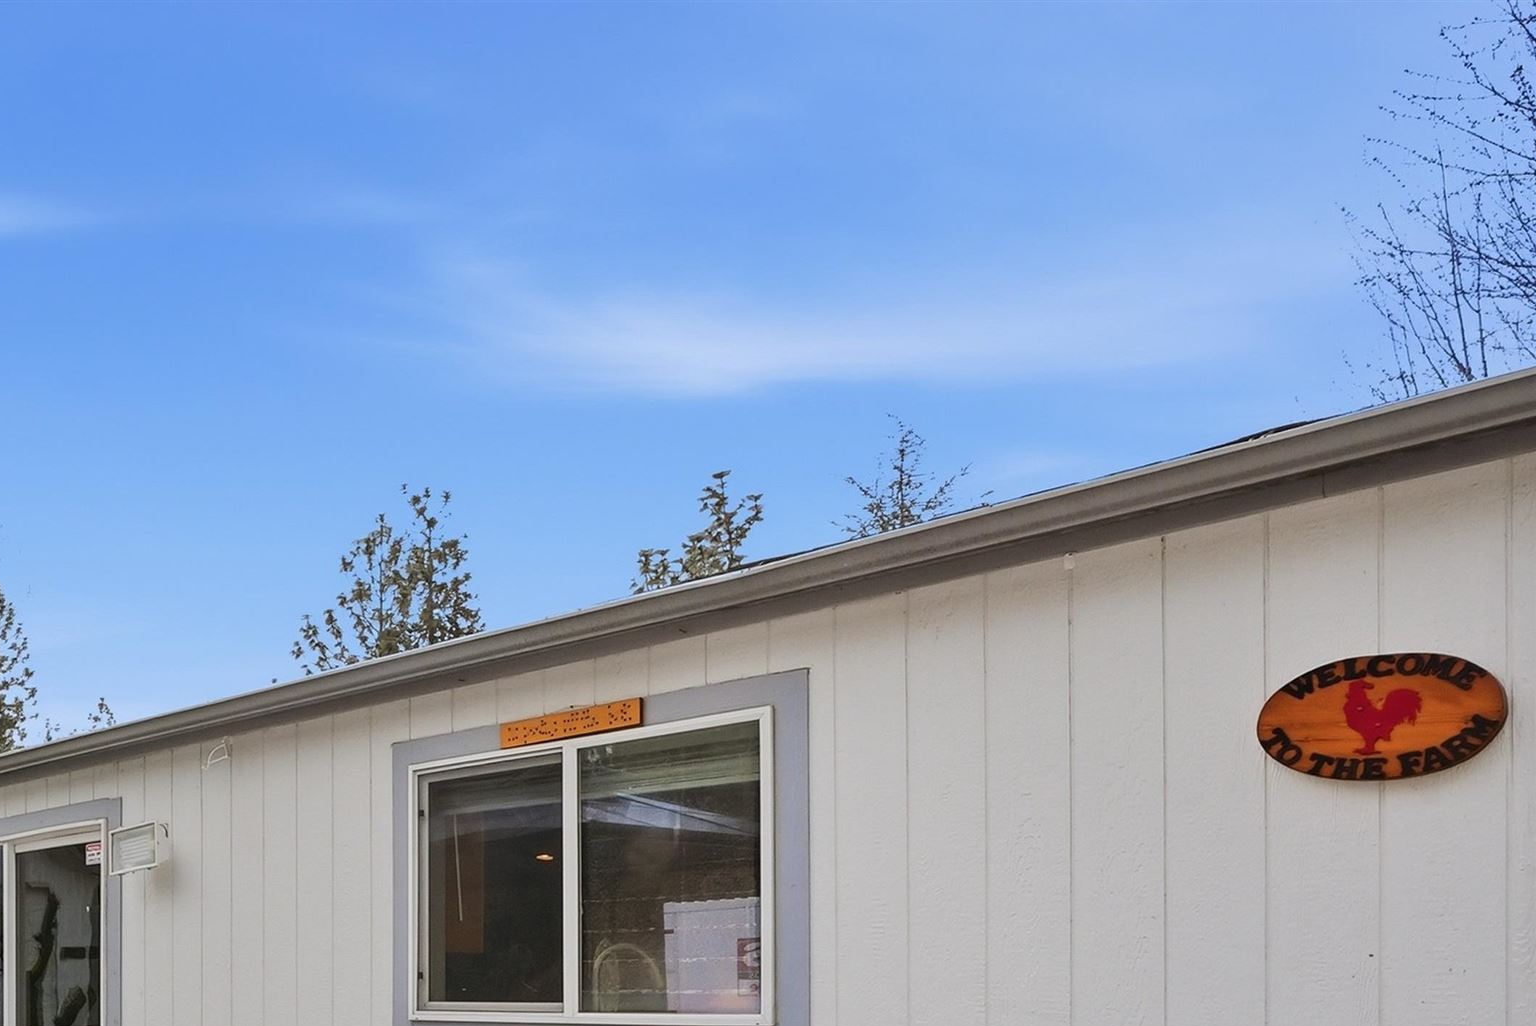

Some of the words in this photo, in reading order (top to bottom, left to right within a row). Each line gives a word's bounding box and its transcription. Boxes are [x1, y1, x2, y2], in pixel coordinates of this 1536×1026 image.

[1281, 654, 1488, 700] WELCOME
[1263, 727, 1303, 766] TO
[1309, 753, 1388, 780] THE
[1396, 713, 1501, 777] FARM
